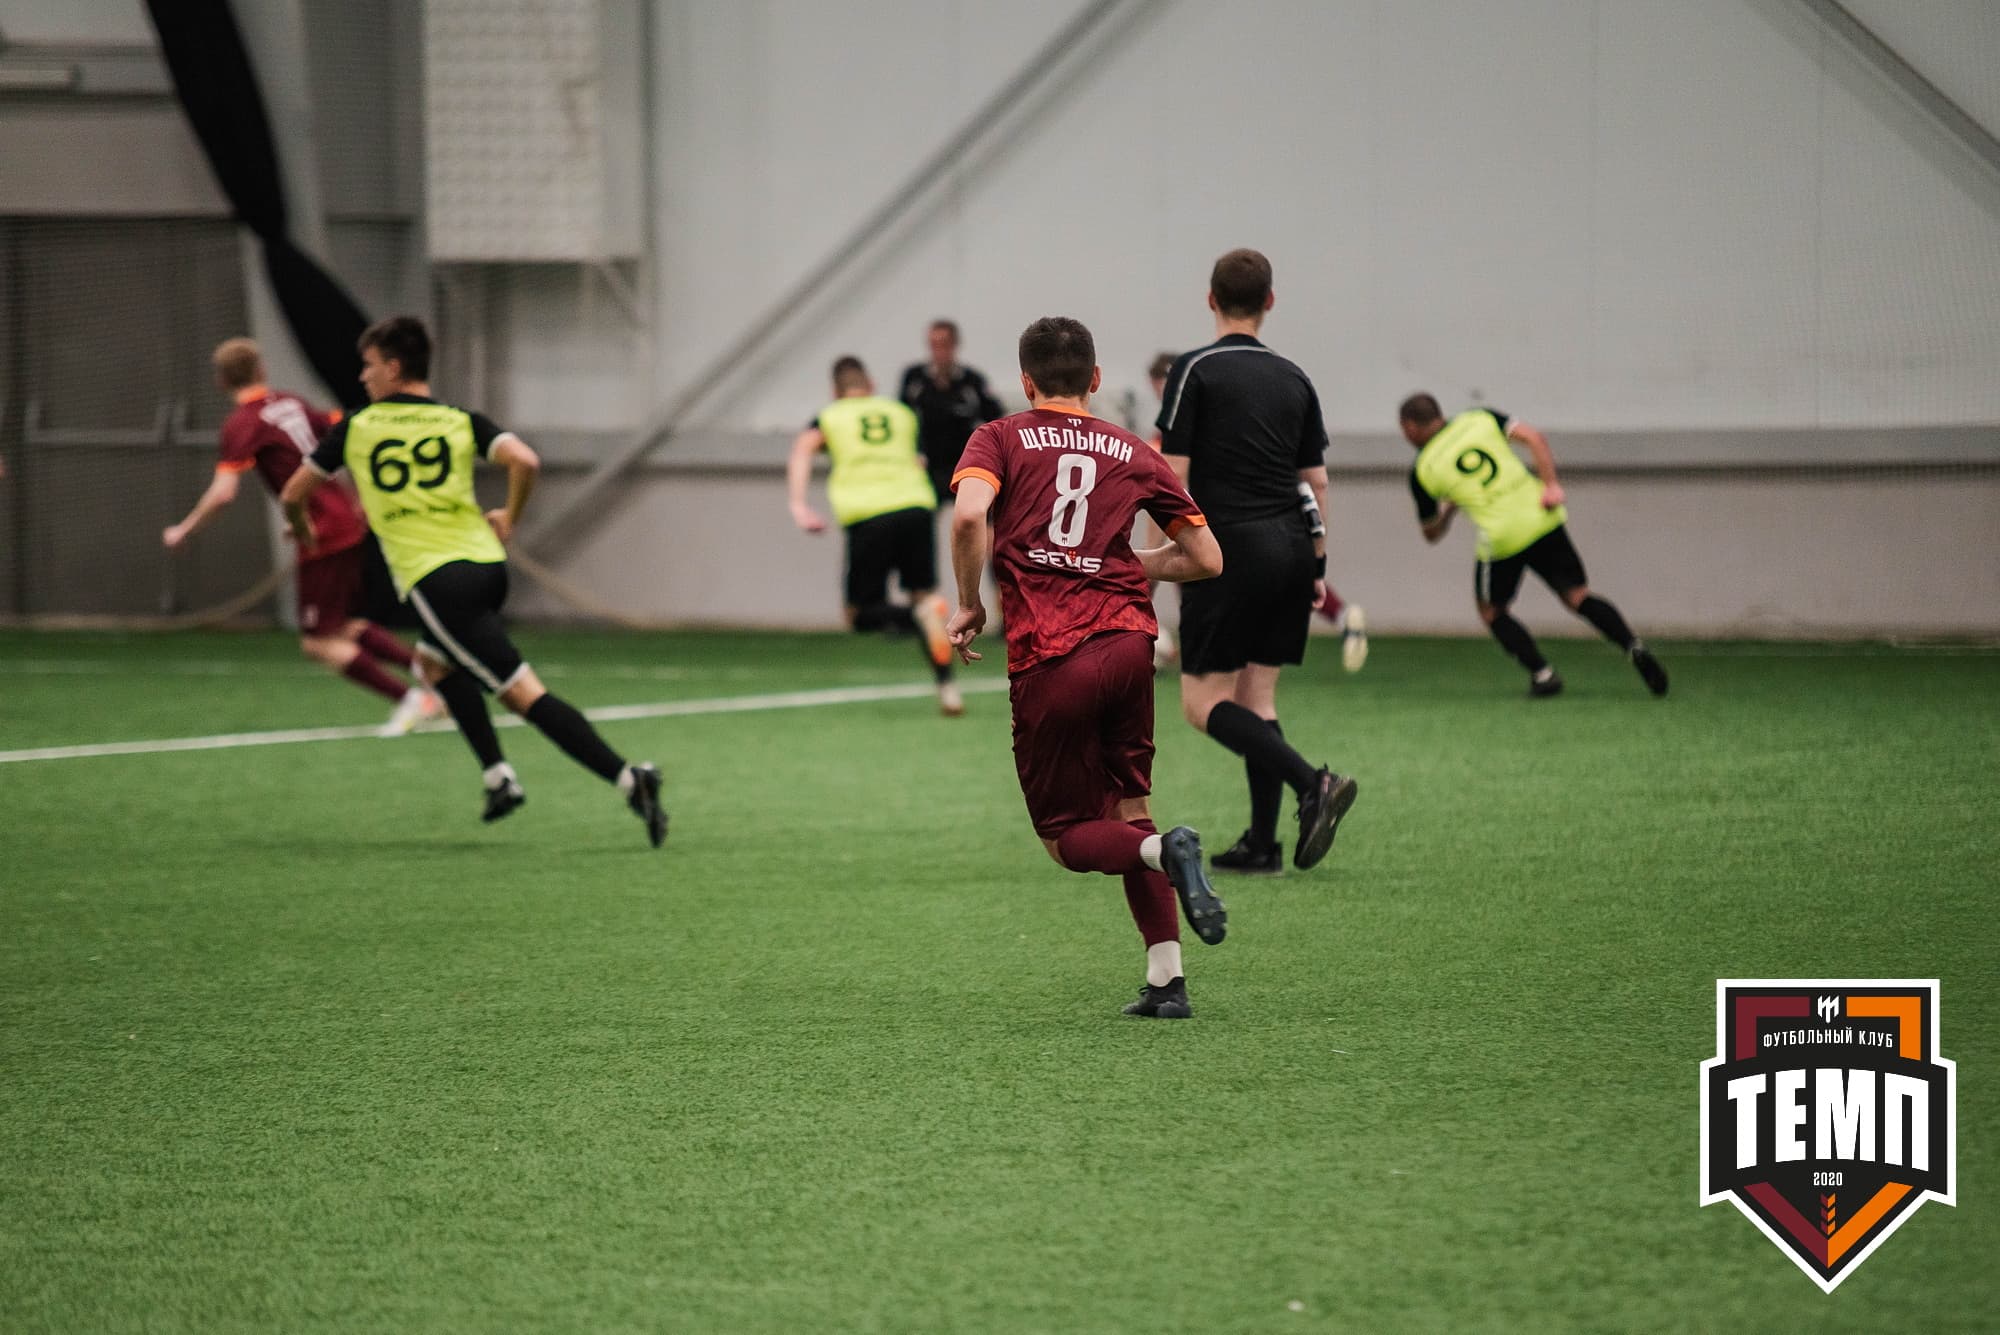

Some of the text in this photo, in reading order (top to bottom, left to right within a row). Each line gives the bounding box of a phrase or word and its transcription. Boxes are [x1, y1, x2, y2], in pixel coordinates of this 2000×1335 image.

[860, 414, 892, 445] 8
[1018, 426, 1134, 464] ЩЕБЛЫКИН
[369, 435, 451, 493] 69
[1455, 448, 1498, 487] 9
[1048, 453, 1097, 548] 8
